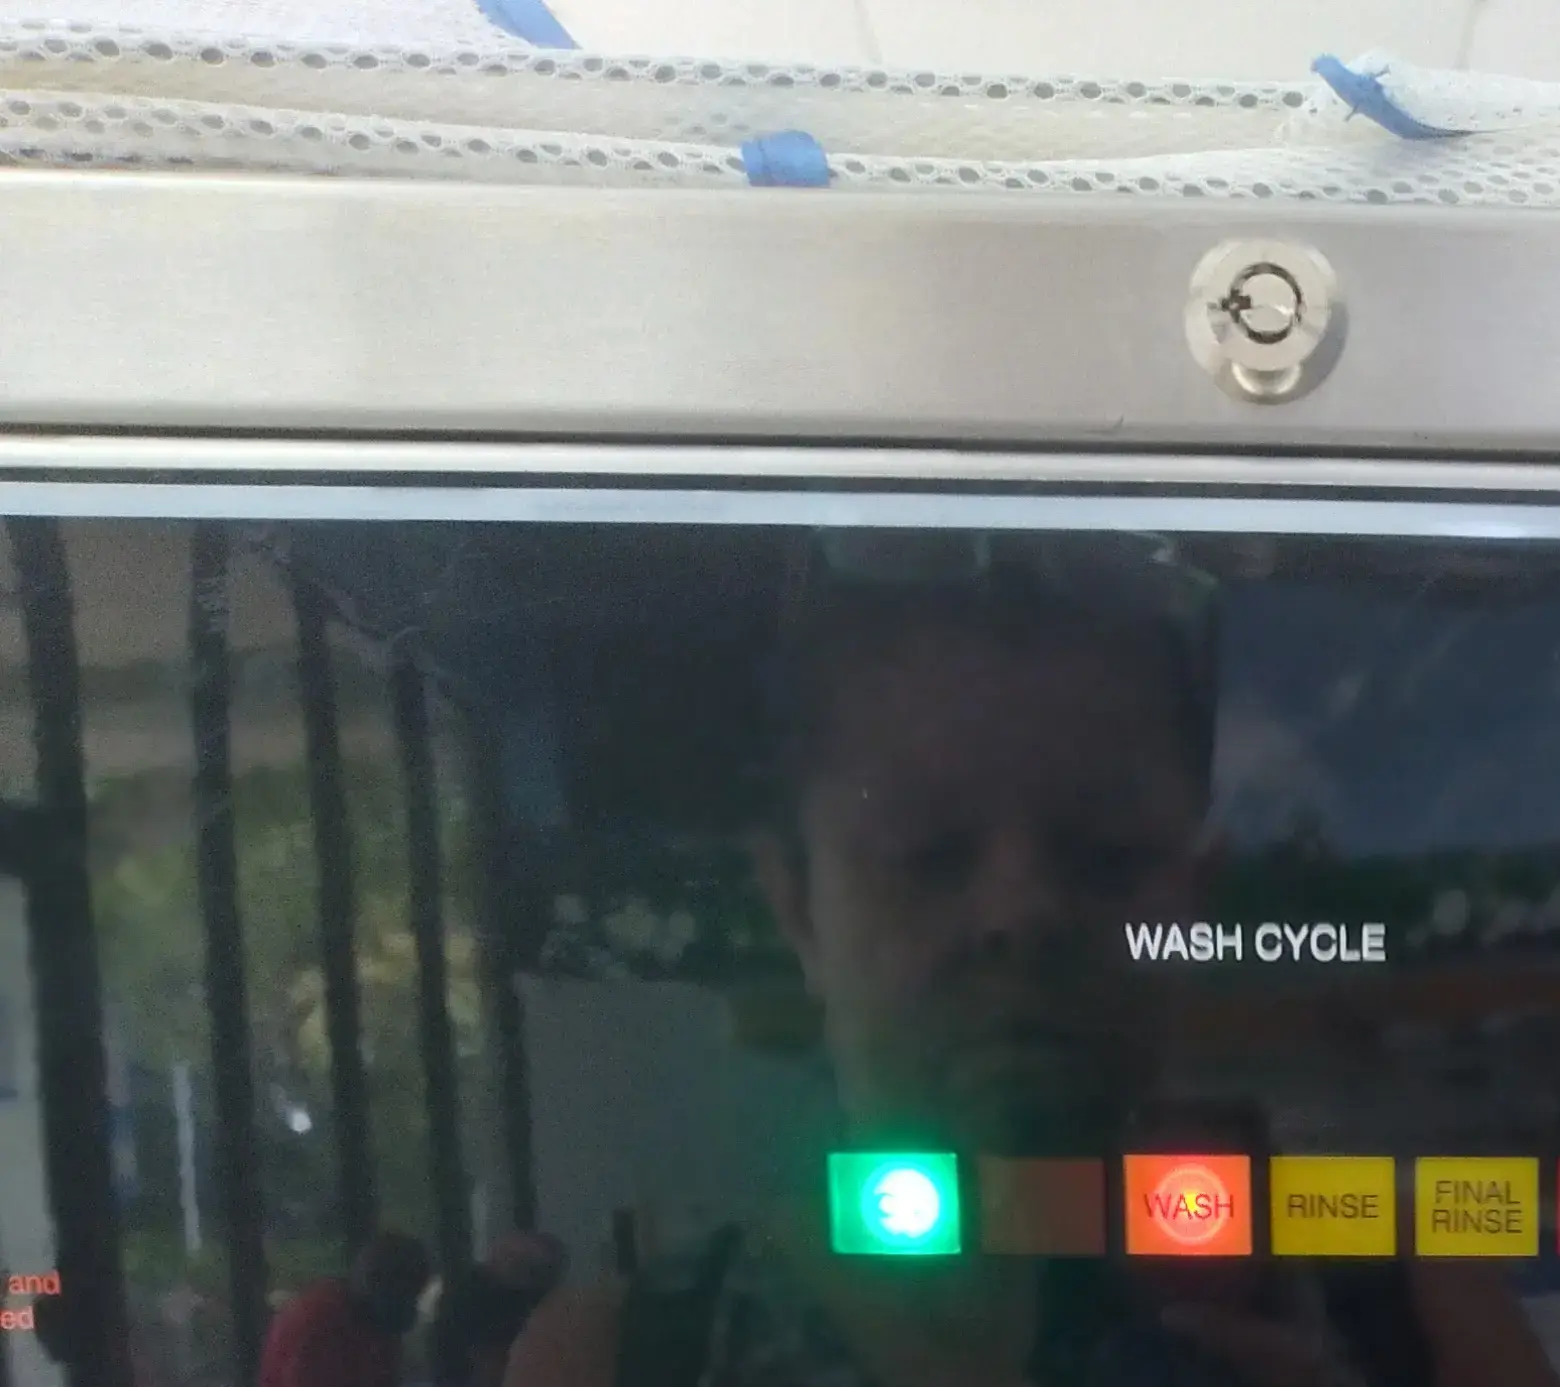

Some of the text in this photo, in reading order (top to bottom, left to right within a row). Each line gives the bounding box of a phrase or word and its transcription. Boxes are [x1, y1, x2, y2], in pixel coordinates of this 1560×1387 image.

[1124, 922, 1387, 962] WASH CYCLE
[1434, 1180, 1521, 1205] FINAL
[1142, 1193, 1235, 1220] WASH
[1287, 1193, 1380, 1219] RINSE
[1430, 1208, 1524, 1235] RINSE
[8, 1269, 61, 1295] and
